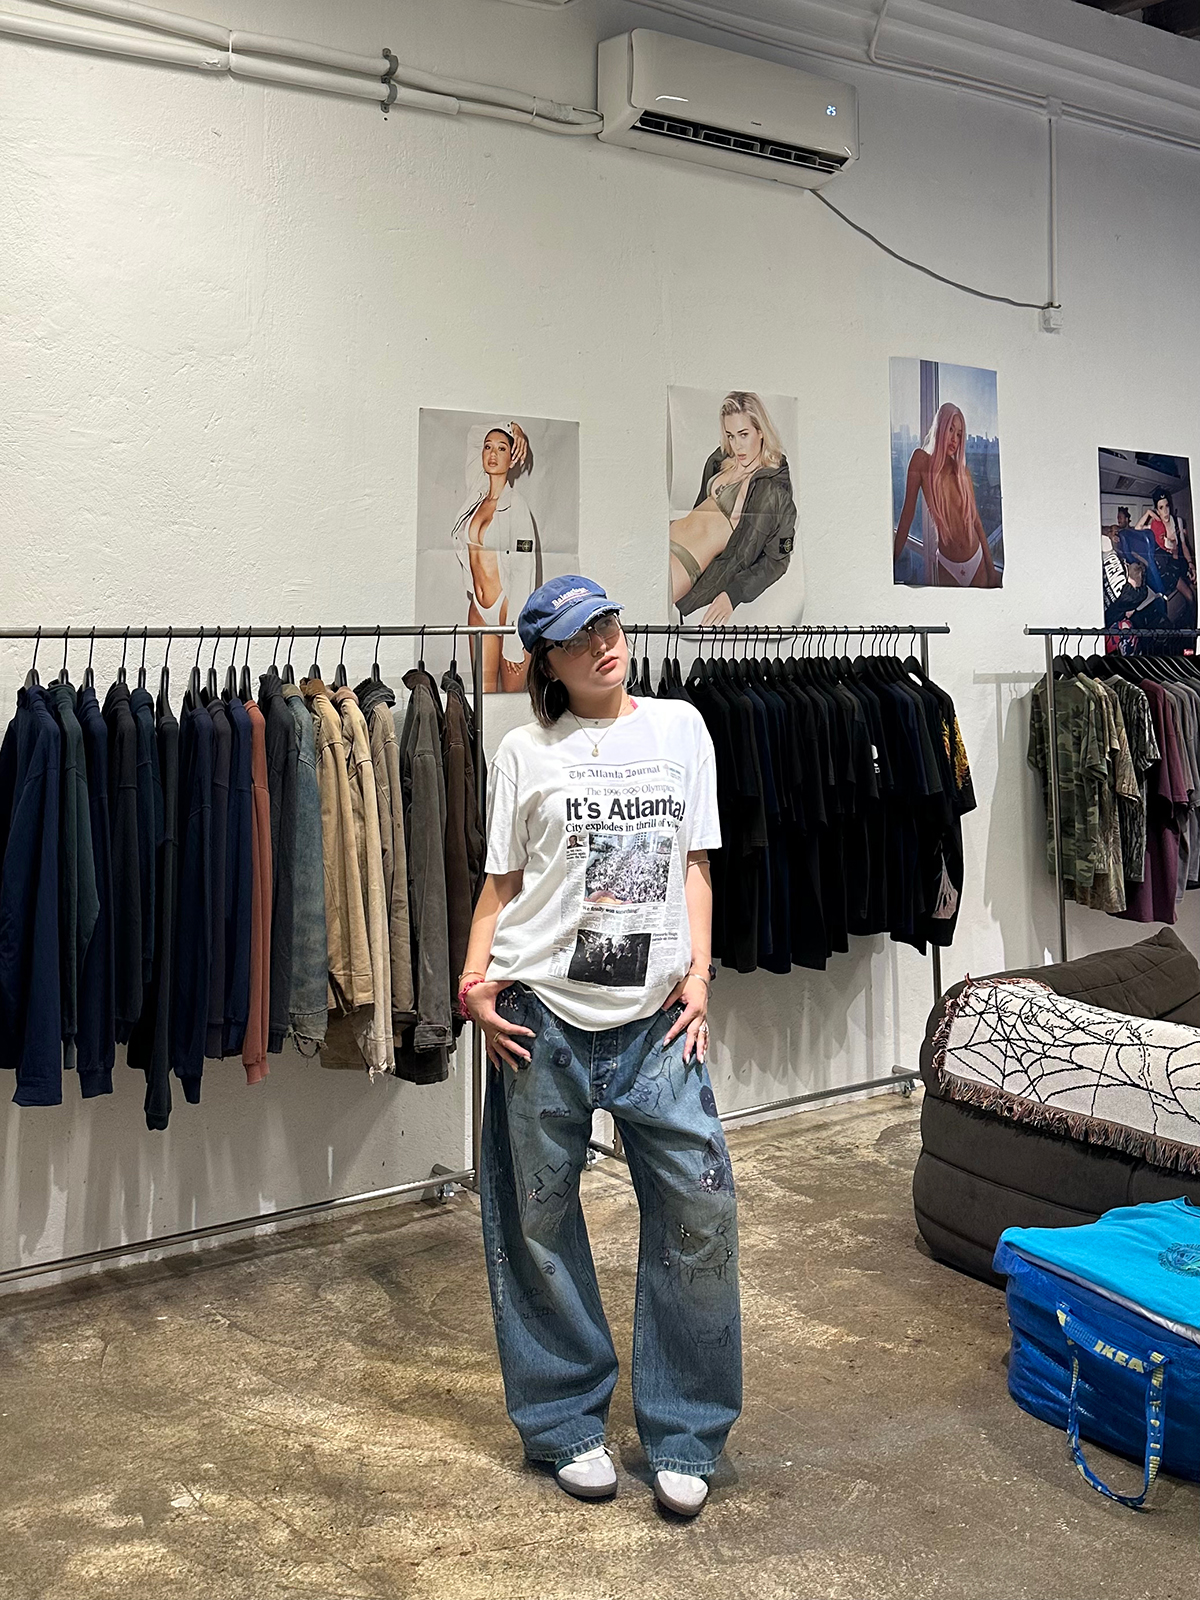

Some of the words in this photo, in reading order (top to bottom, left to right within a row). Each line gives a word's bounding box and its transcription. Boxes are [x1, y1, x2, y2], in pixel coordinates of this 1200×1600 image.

[826, 105, 837, 116] 25
[568, 769, 586, 780] The
[587, 767, 624, 779] Atlanta
[625, 765, 661, 778] Journal
[585, 787, 602, 796] The
[603, 787, 622, 796] 1996
[641, 784, 676, 794] Olympics
[566, 797, 601, 821] It's
[608, 795, 686, 822] Atlanta!
[565, 822, 584, 833] City
[585, 820, 624, 832] explodes
[625, 822, 634, 831] in
[635, 818, 657, 831] thrill
[657, 818, 666, 828] of
[1093, 1340, 1145, 1374] IKEA
